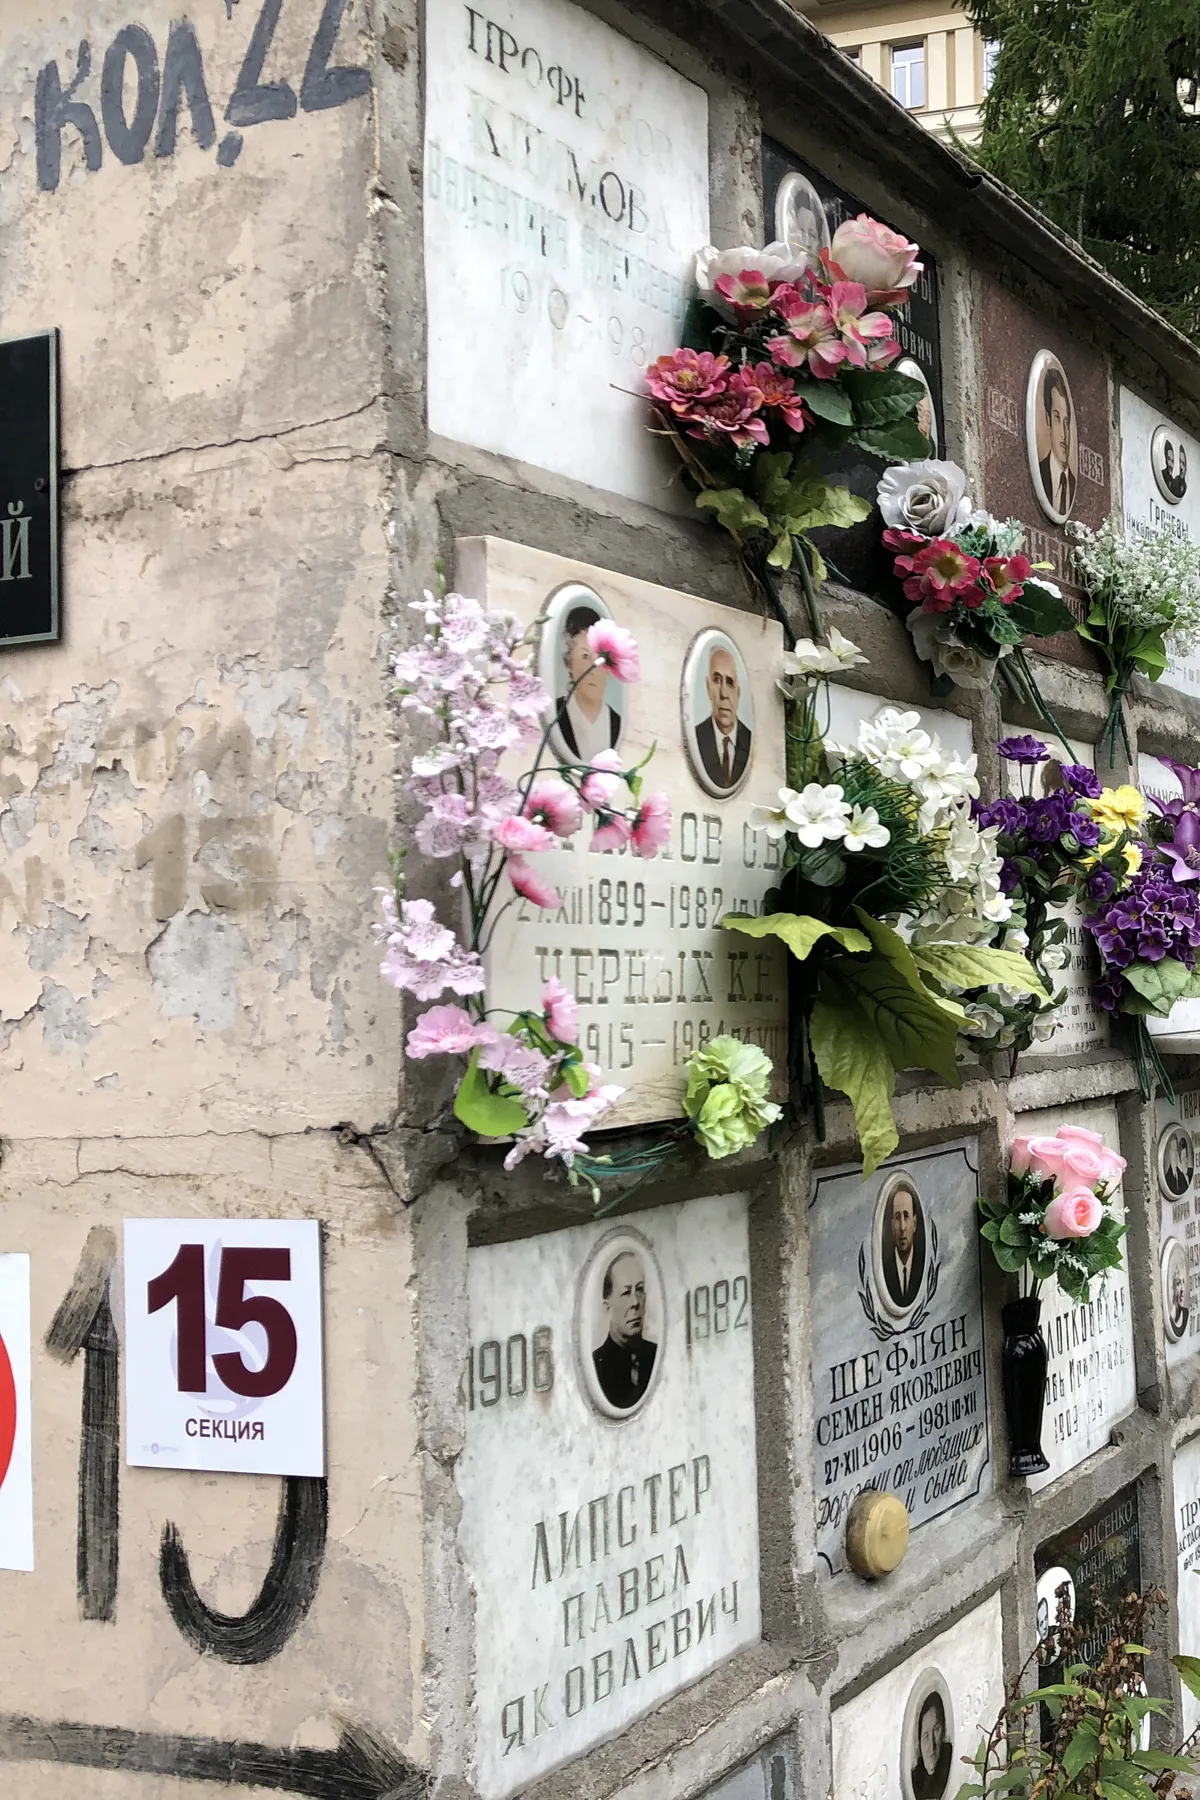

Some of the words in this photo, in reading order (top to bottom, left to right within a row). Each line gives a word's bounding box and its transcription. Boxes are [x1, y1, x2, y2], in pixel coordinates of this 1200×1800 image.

[147, 1243, 298, 1399] 15
[685, 1274, 750, 1349] 1982
[465, 1325, 555, 1413] 1906
[816, 1391, 884, 1447] СЕМЕН
[889, 1348, 983, 1416] ЯКОВЛЕВИЧ
[829, 1315, 968, 1405] ШЕФЛЯН
[185, 1418, 265, 1443] СЕКЦИЯ
[529, 1452, 713, 1591] ЛИПСТЕР
[1080, 1499, 1133, 1556] ФИСЕНКО
[561, 1543, 691, 1649] ПАВЕЛ
[501, 1580, 740, 1758] ЯКОВЛЕВИЧ
